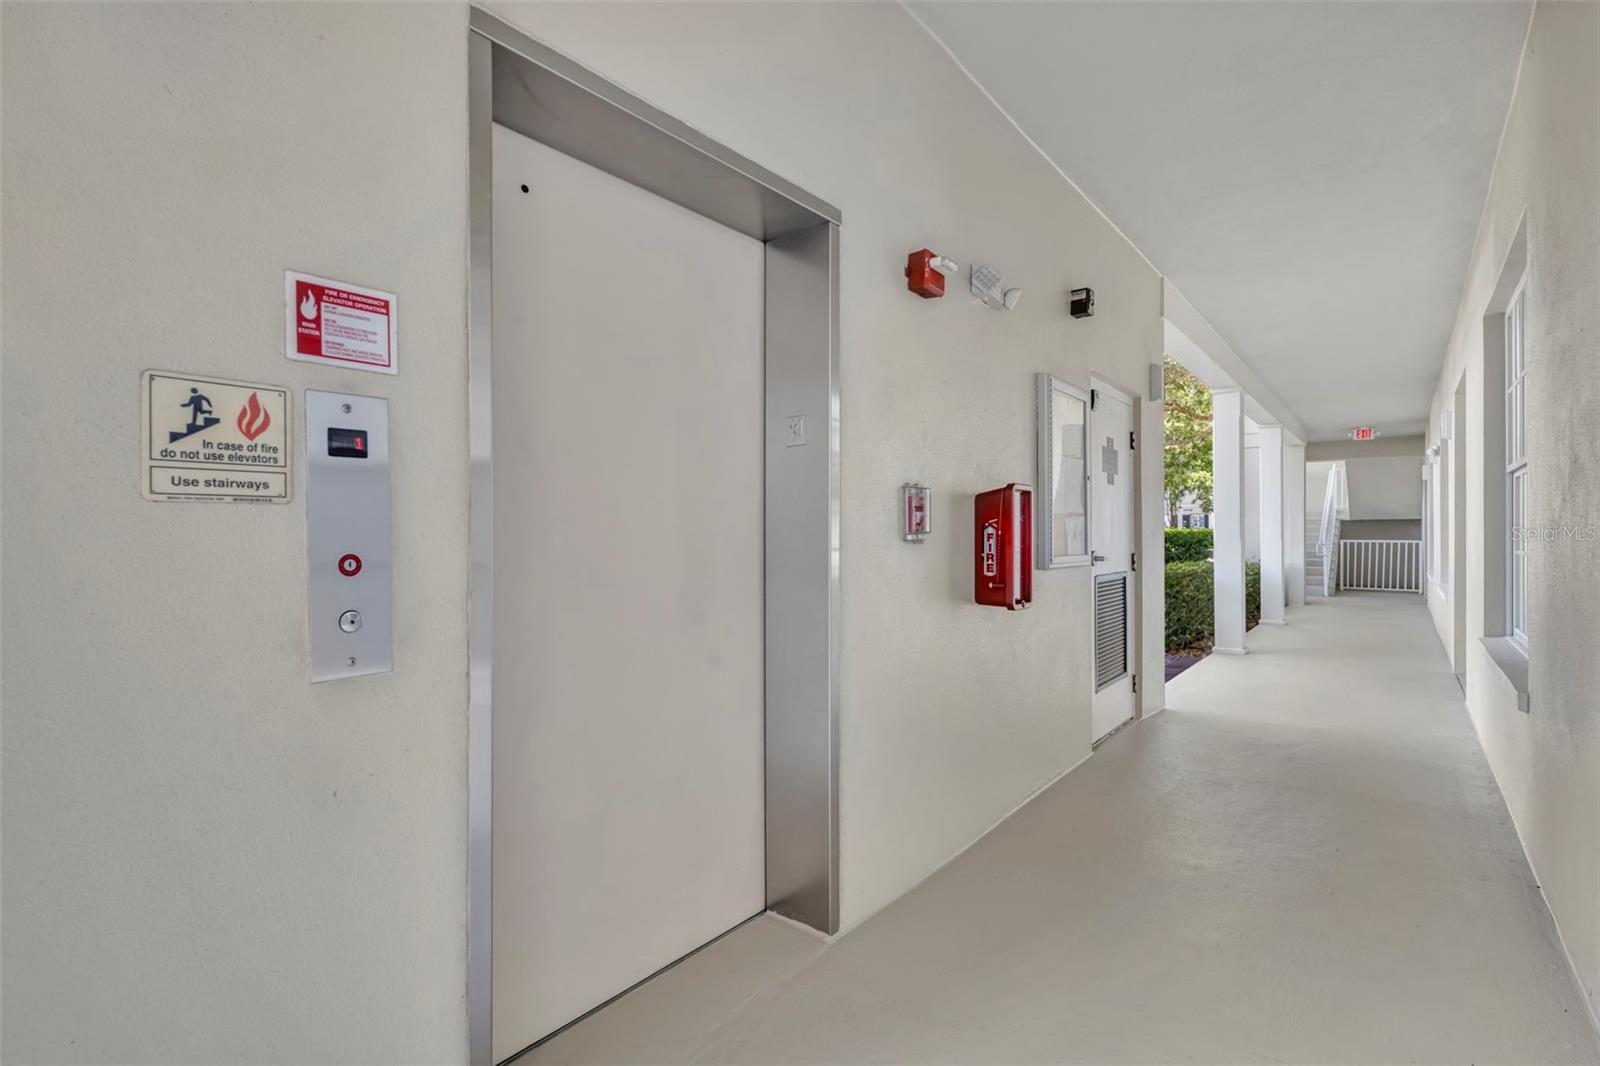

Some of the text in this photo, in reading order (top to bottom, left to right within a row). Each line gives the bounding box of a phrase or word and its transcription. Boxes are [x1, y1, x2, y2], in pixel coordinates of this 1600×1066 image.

[322, 295, 387, 314] ELEVATOR OPERATION
[324, 289, 337, 297] FIRE
[349, 294, 385, 307] EMERGENCY
[298, 327, 320, 336] STATION
[1356, 429, 1372, 439] EXIT
[202, 439, 279, 454] In case of fire
[354, 436, 364, 450] 1
[160, 448, 279, 465] do not use elevators
[171, 475, 270, 492] Use stairways
[986, 532, 994, 573] FIRE
